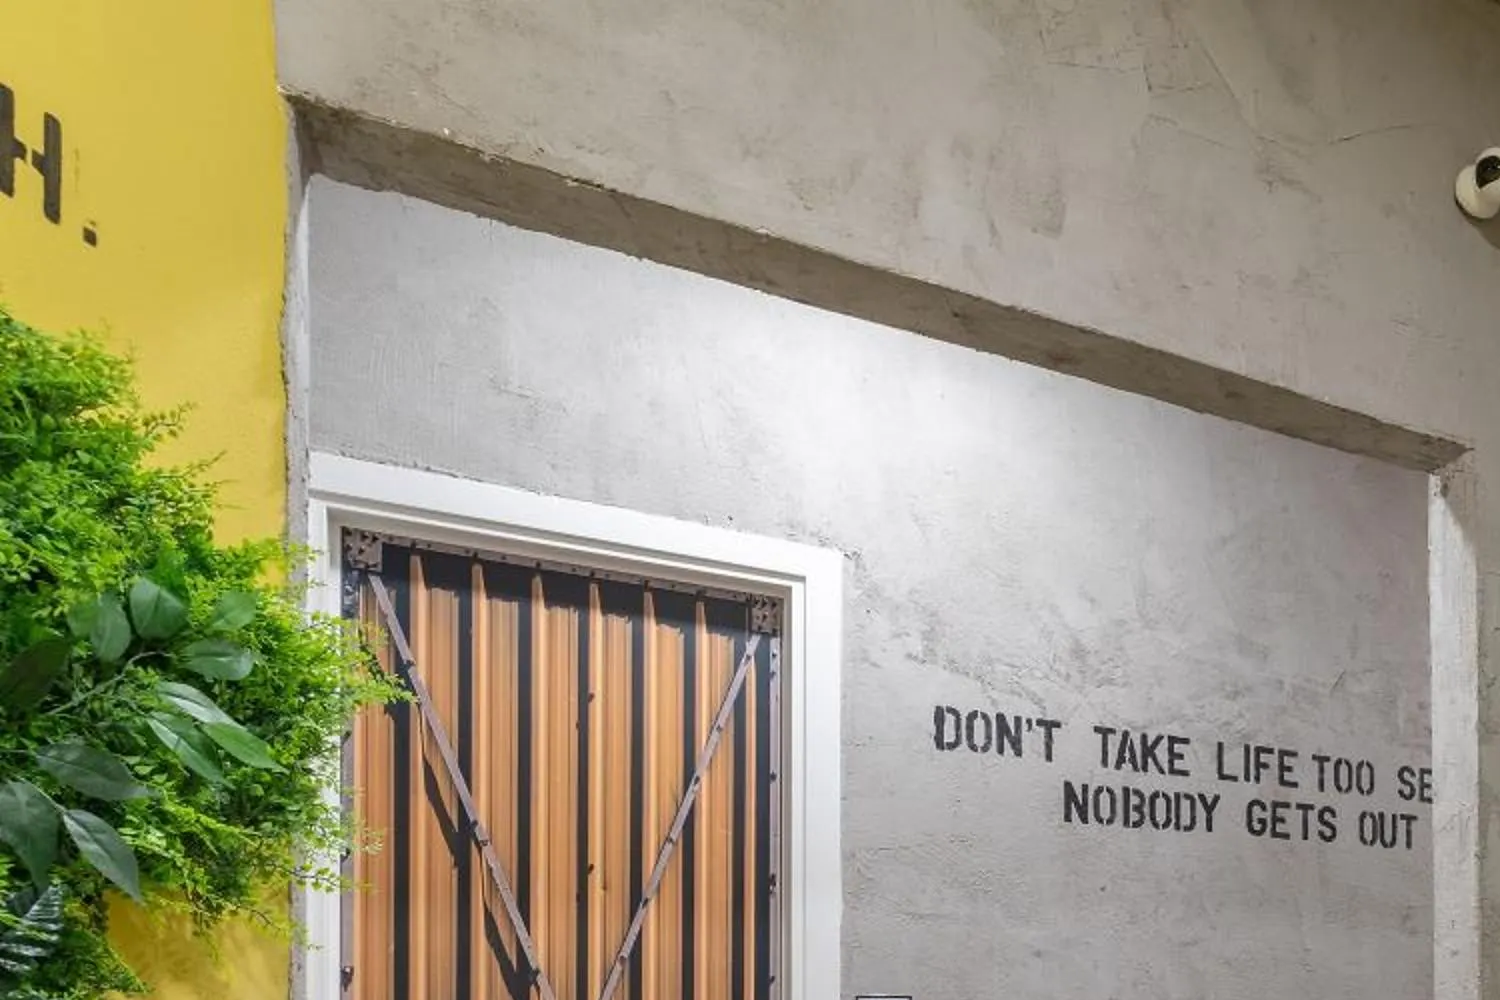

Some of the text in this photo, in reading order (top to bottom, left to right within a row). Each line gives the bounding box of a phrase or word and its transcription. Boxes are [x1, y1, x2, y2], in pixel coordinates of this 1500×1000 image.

[933, 704, 1061, 763] DON'T
[1093, 724, 1190, 777] TAKE
[1216, 741, 1299, 789] LIFE
[1312, 753, 1374, 796] TOO
[1062, 780, 1418, 850] NOBODY GETS OUT
